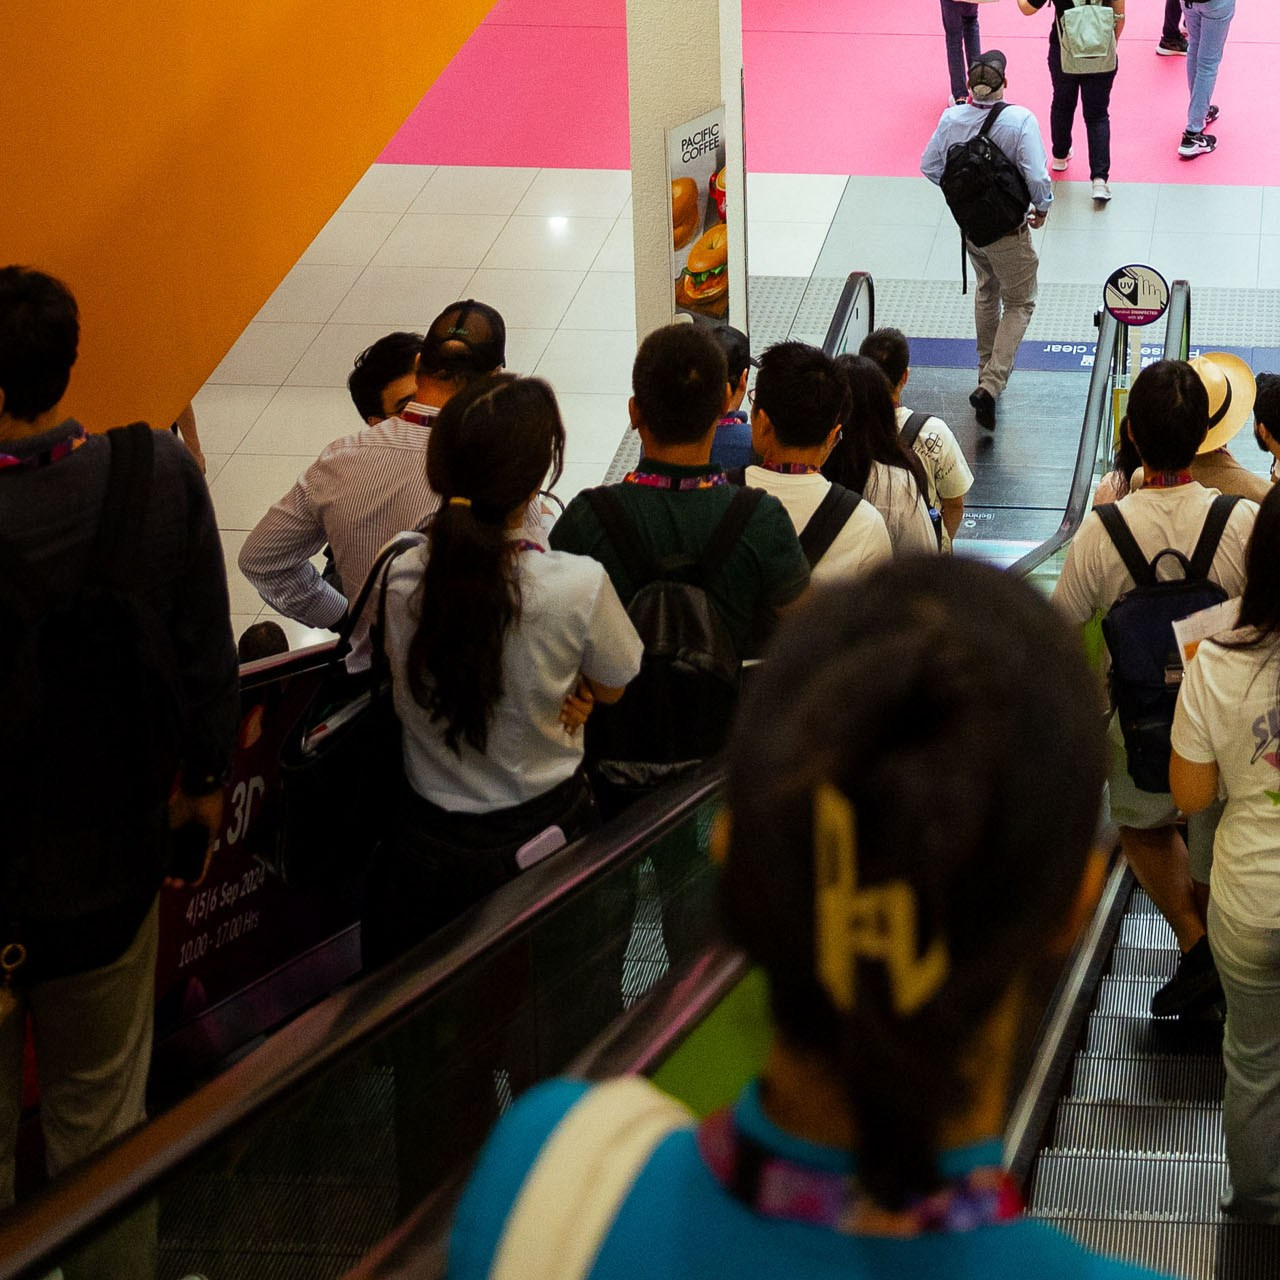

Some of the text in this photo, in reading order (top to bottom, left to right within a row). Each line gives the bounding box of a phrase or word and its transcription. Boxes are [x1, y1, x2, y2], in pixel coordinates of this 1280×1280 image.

[681, 123, 719, 152] PACIFIC
[681, 136, 720, 164] COFFEE
[1044, 345, 1087, 355] clear
[219, 879, 240, 907] Sep
